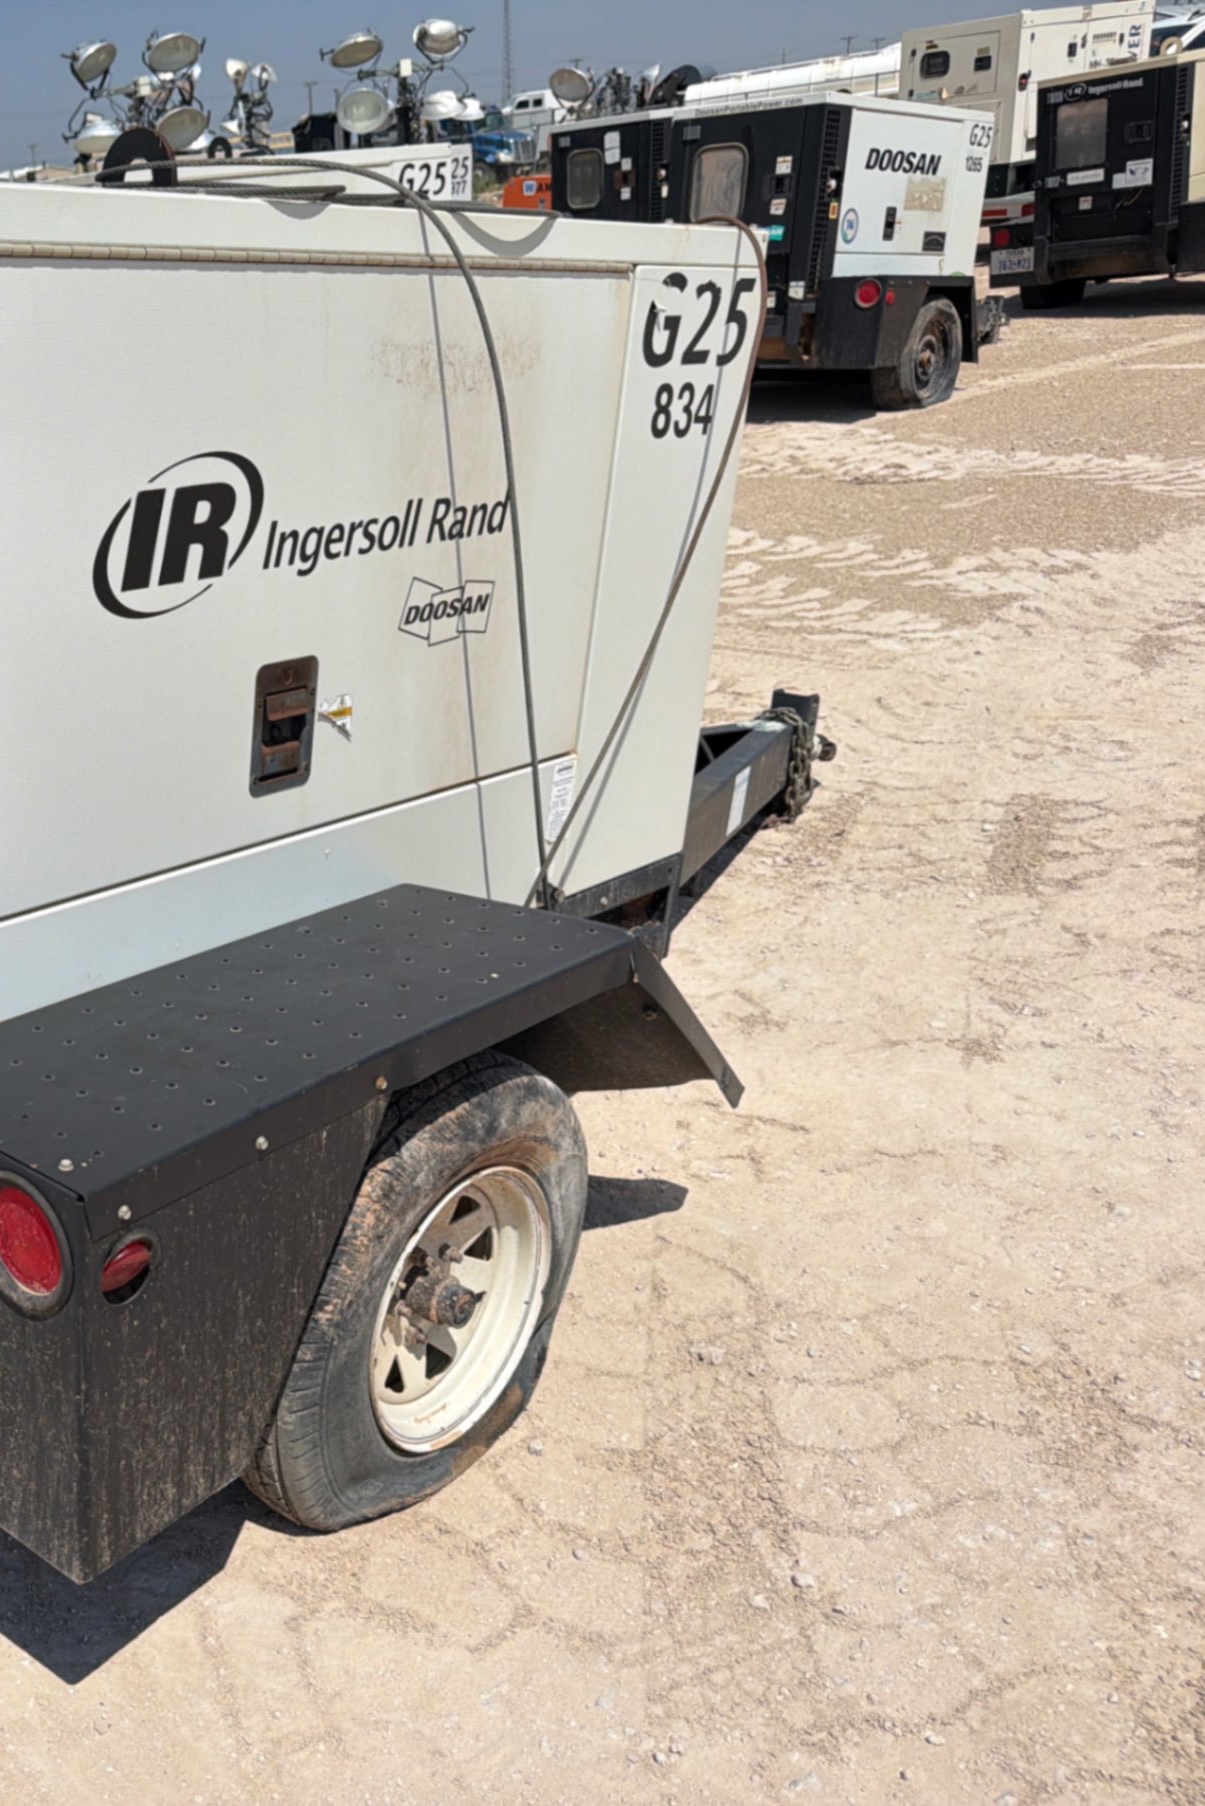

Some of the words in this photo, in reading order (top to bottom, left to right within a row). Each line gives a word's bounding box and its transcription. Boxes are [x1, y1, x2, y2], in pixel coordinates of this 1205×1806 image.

[969, 123, 993, 149] G25
[450, 156, 470, 180] 25
[864, 147, 942, 176] DOOSAN
[399, 162, 446, 196] G25
[642, 272, 757, 369] G25
[650, 381, 715, 440] 834
[262, 497, 424, 578] Ingersoll
[425, 485, 511, 544] Rand
[403, 593, 490, 626] DOOSAN
